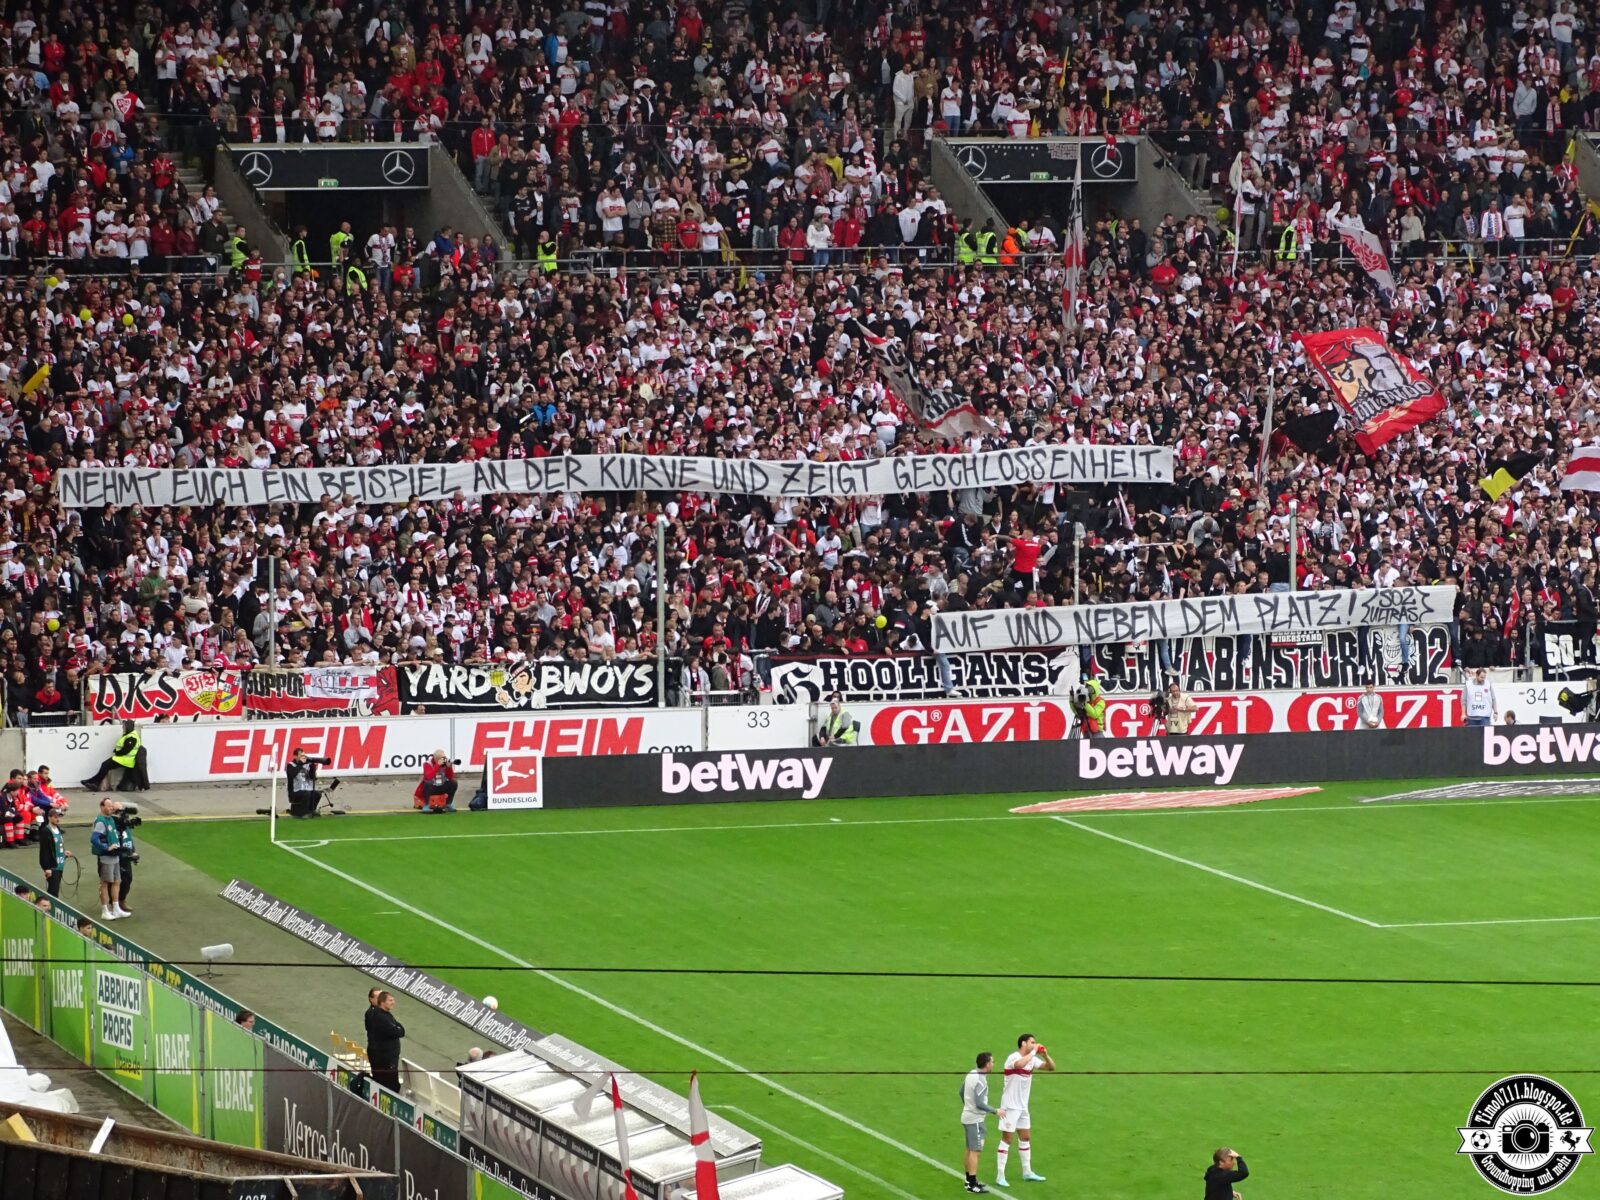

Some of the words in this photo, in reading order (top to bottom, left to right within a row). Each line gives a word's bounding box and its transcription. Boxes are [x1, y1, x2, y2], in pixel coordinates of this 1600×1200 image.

[63, 470, 161, 505] NEHMT
[173, 470, 248, 504] EUCH
[263, 470, 312, 503] EIN
[318, 464, 461, 503] BEISPIEL
[474, 461, 510, 492] AN
[525, 456, 589, 491] DER
[601, 456, 700, 489] KURVE
[712, 460, 769, 493] UND
[781, 459, 881, 496] ZEIGT
[893, 449, 1163, 491] GESCHLOSSENHEIT.
[934, 613, 993, 650] AUF
[1005, 609, 1063, 647] UND
[1073, 602, 1170, 644] NEBEN
[1181, 598, 1244, 636] DEM
[1271, 633, 1323, 643] WIDERSTAND
[406, 663, 490, 699] YARD
[541, 662, 656, 698] BWOYS
[819, 653, 1049, 692] HOOLIGANS
[95, 672, 179, 713] DKS
[1525, 688, 1548, 705] 34
[747, 711, 771, 729] 33
[66, 732, 90, 750] 32
[661, 752, 834, 800] betway
[1079, 739, 1245, 785] betway
[491, 796, 538, 805] BUNDESLIGA
[3, 938, 35, 977] LIBARE
[220, 879, 270, 916] Mercedes-Benz
[263, 900, 288, 925] Bank
[280, 908, 332, 947] Mercedes-Benz
[325, 931, 350, 957] Bank
[340, 939, 394, 980] Mercedes-Benz
[388, 966, 416, 992] Bank
[406, 973, 464, 1015] Mercedes-Benz
[458, 1000, 484, 1027] Bank
[52, 969, 84, 1009] LIBARE
[97, 973, 140, 1012] ABBRUCH
[103, 1012, 133, 1047] PROFIS
[155, 1033, 192, 1075] LIBARE
[214, 1067, 254, 1112] LIBARE
